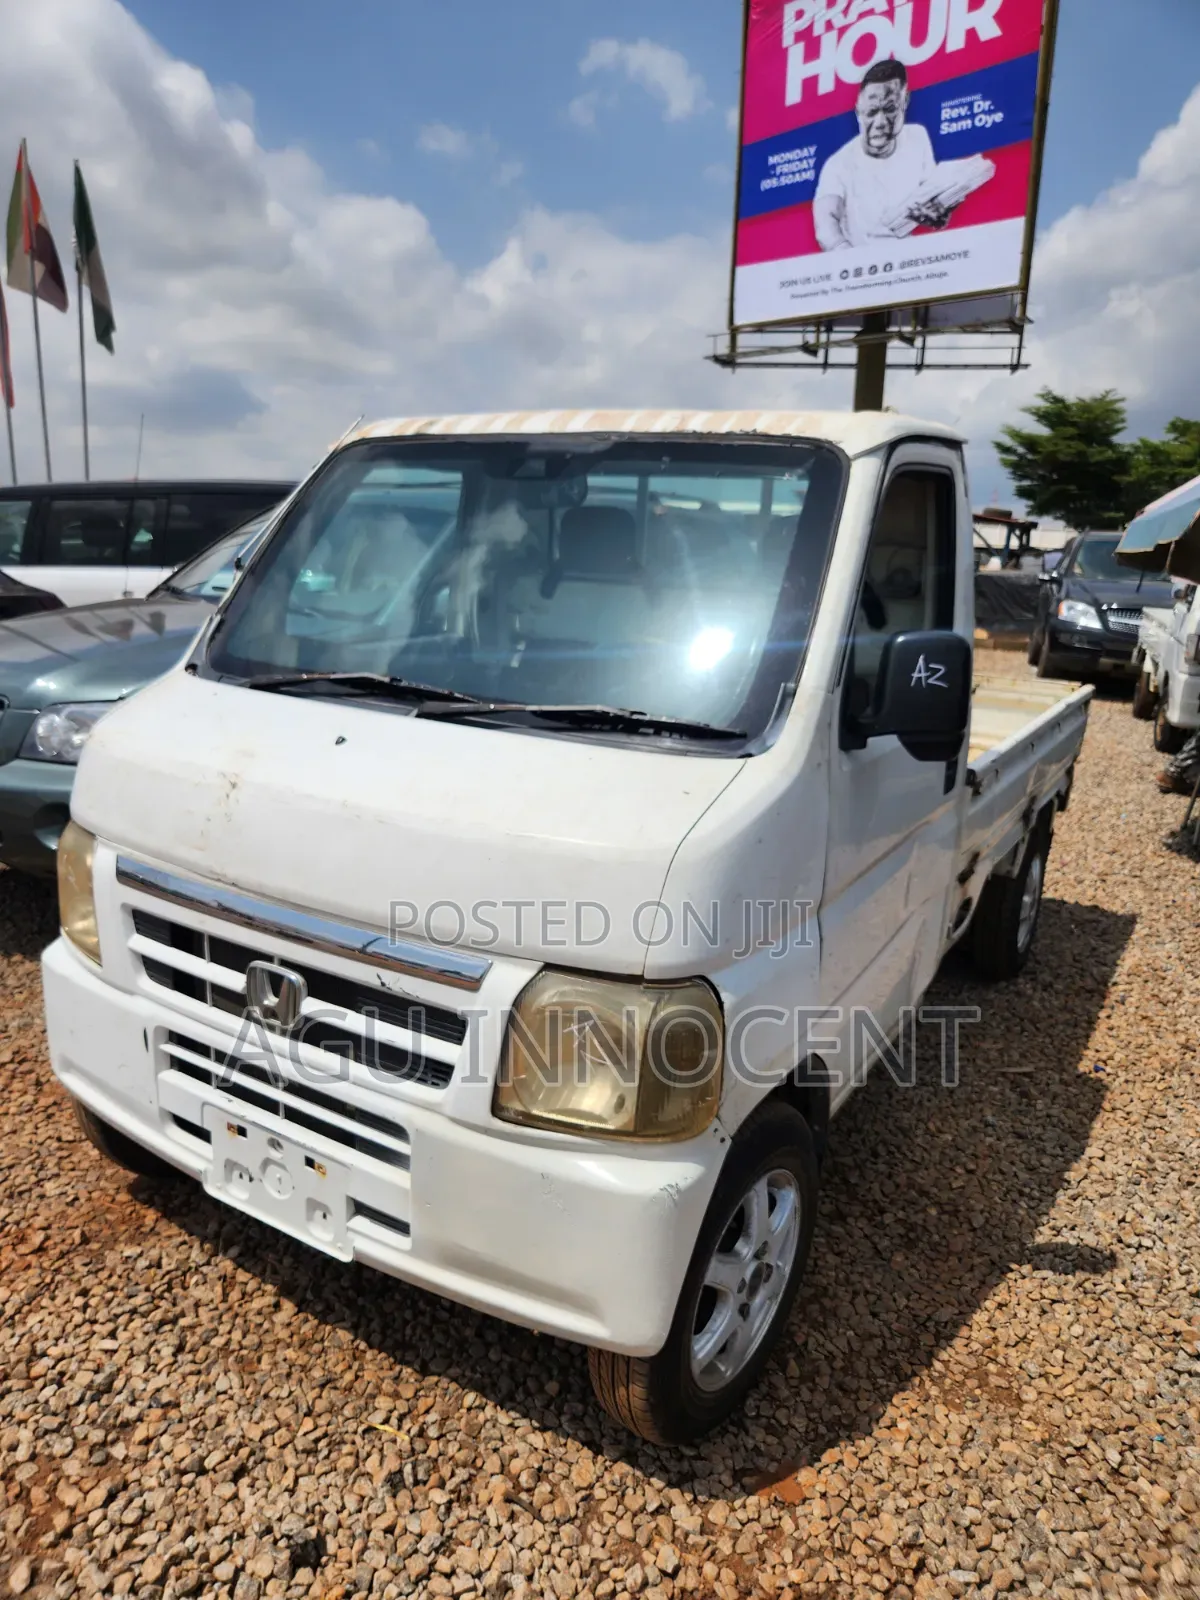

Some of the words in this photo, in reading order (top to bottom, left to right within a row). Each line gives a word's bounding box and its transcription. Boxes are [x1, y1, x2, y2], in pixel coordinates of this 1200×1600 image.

[785, 0, 1003, 107] HOUR
[941, 106, 971, 121] Rev.
[973, 100, 995, 114] Dr.
[940, 119, 972, 135] Sam
[974, 112, 1004, 128] Oye
[768, 145, 817, 167] MONDAY
